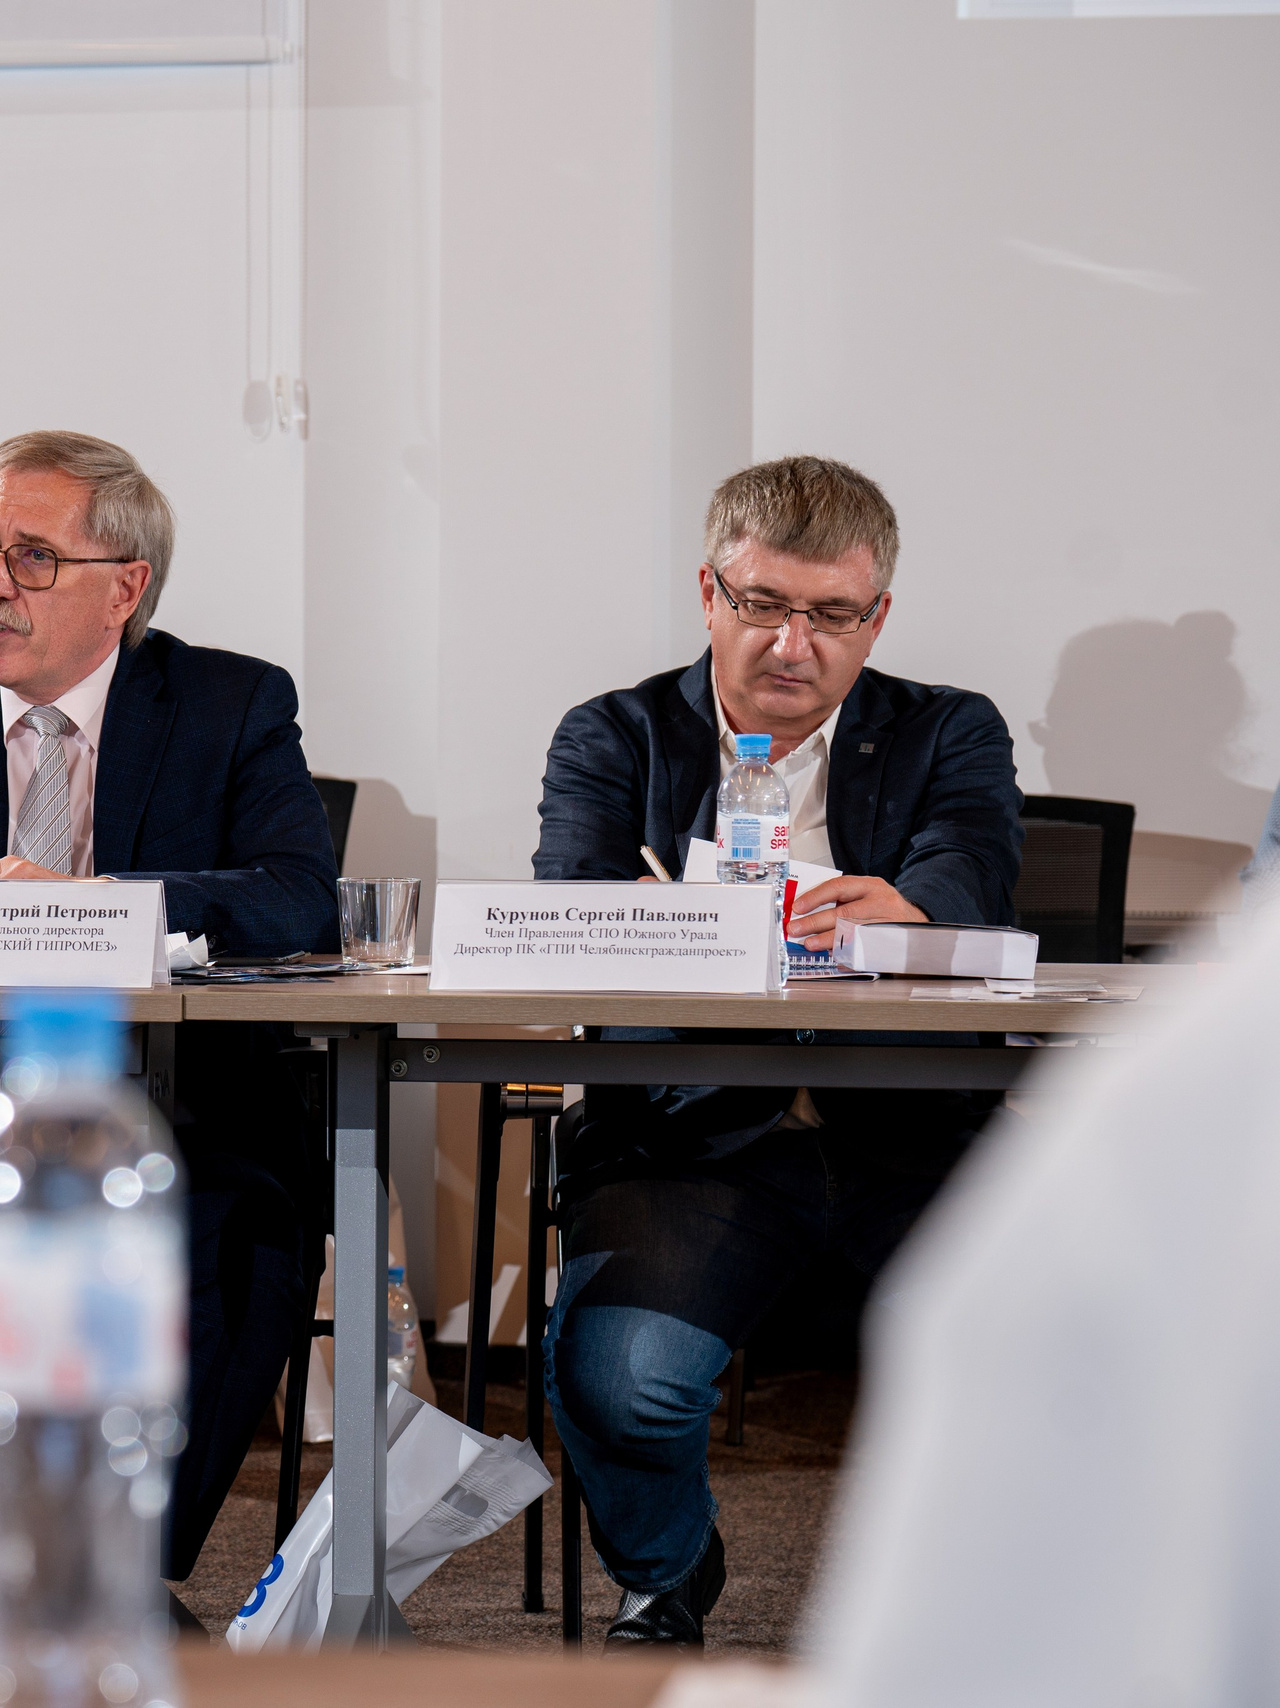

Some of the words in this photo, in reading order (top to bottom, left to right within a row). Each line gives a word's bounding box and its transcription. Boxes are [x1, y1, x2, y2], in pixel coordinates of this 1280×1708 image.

[46, 904, 129, 920] Петрович
[486, 907, 560, 923] Курунов
[564, 907, 626, 923] Сергей
[631, 907, 719, 923] Павлович
[42, 927, 104, 937] директора
[485, 927, 515, 939] Член
[518, 927, 584, 940] Правления
[588, 927, 620, 939] СПО
[623, 928, 677, 941] Южного
[680, 928, 718, 941] Урала
[36, 939, 118, 952] ГИПРОМЕЗ»
[453, 943, 513, 957] Директор
[516, 943, 536, 955] ПК
[539, 943, 576, 955] «ГПИ
[579, 943, 747, 959] Челябинскгражданпроект»
